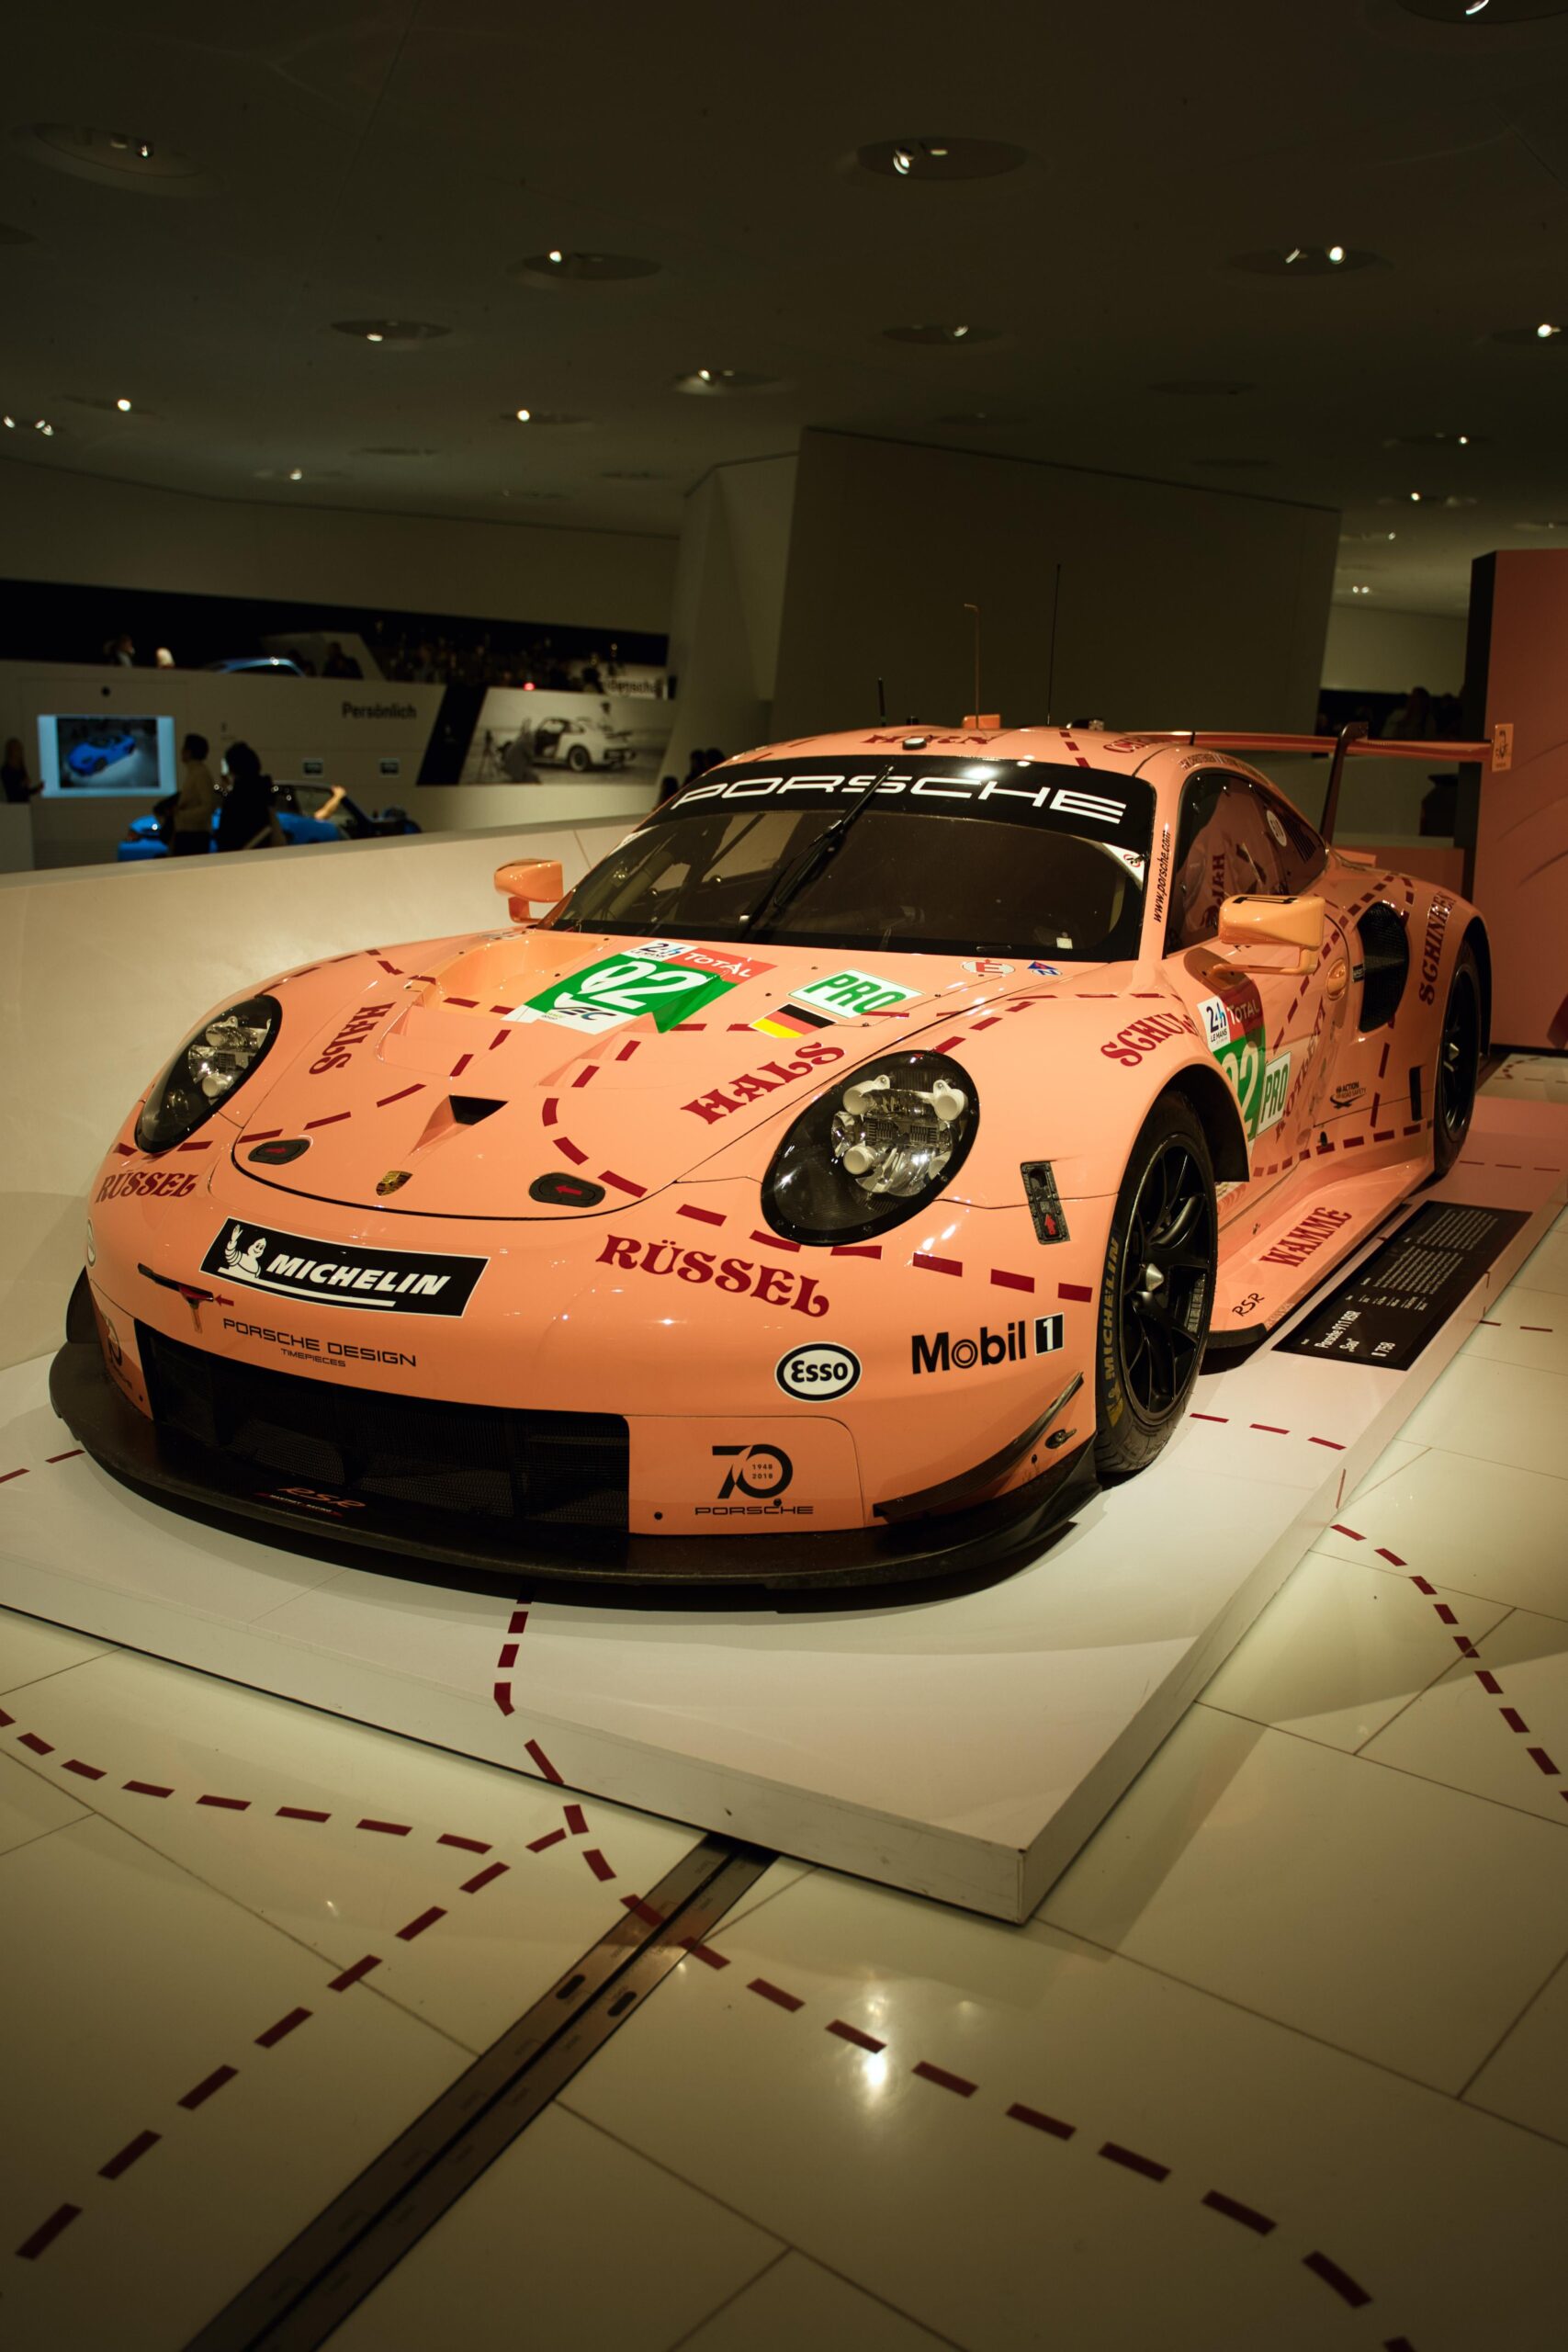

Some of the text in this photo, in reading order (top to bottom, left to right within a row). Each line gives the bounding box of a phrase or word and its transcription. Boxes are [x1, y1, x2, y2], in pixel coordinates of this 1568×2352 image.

[342, 701, 417, 719] Persönlich
[671, 775, 1128, 824] PORSCHE
[684, 952, 752, 978] TOTAL
[803, 973, 907, 1013] PRO
[1226, 999, 1260, 1025] TOTAL
[681, 1042, 846, 1125] HALS
[1260, 1063, 1289, 1124] PRO
[266, 1253, 452, 1295] MICHELIN
[596, 1234, 829, 1317] RÜSSEL
[1103, 1236, 1119, 1380] MICHELIN
[1233, 1292, 1265, 1317] RSR
[223, 1317, 416, 1367] PORSCHE DESIGN
[280, 1348, 346, 1368] TIMEPIECES
[912, 1321, 1027, 1374] Mobil
[790, 1358, 849, 1385] Esso
[712, 1443, 794, 1499] 70
[751, 1463, 773, 1471] 1948
[751, 1472, 773, 1480] 2018
[694, 1506, 814, 1516] PORSCHE
